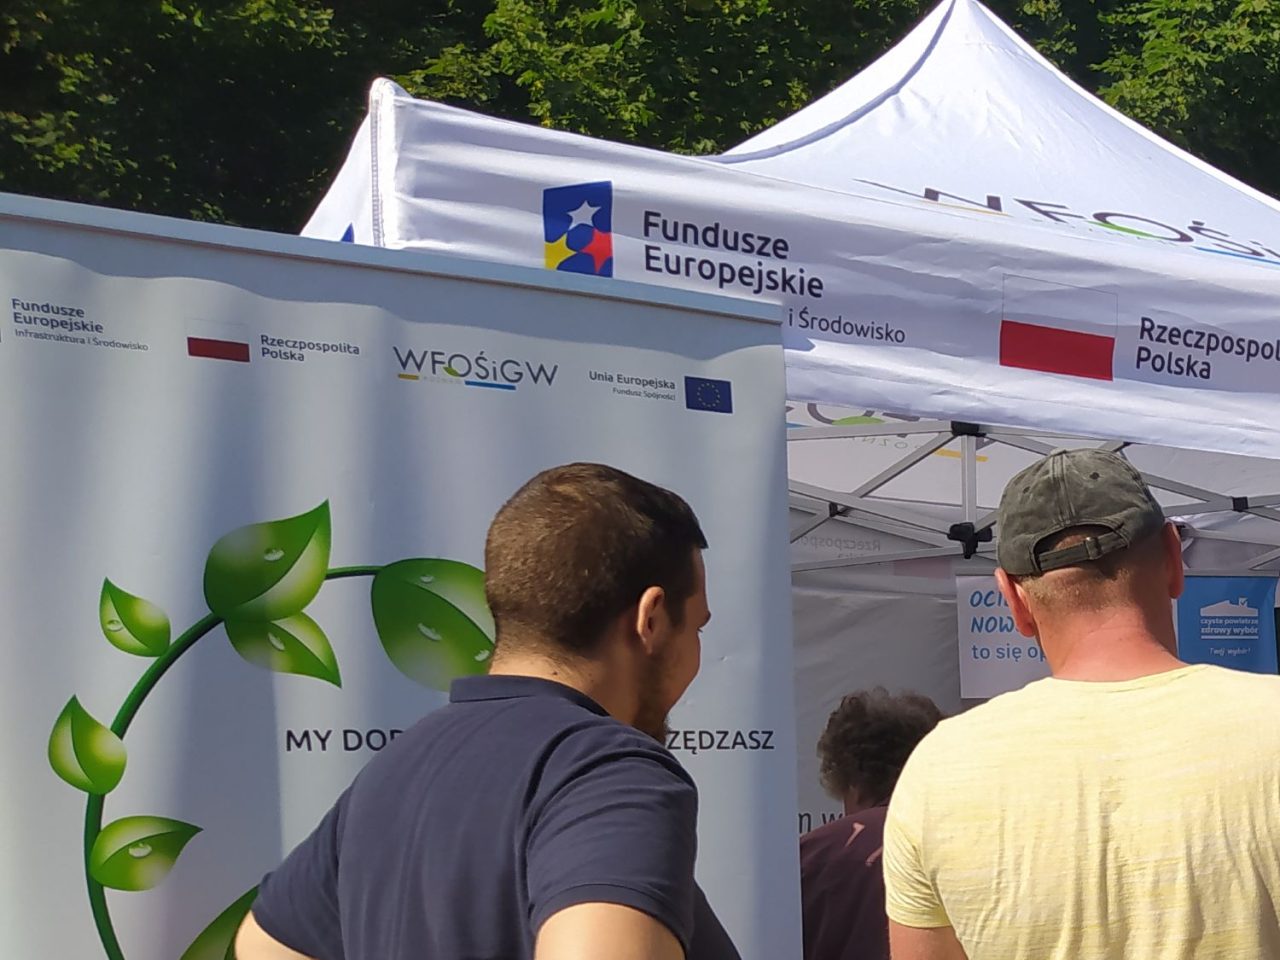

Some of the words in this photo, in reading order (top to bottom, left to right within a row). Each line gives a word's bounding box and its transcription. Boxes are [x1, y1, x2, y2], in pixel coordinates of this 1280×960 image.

[643, 210, 789, 260] Fundusze
[645, 244, 823, 298] Europejskie
[12, 299, 84, 318] Fundusze
[13, 312, 104, 334] Europejskie
[788, 308, 794, 327] i
[798, 307, 906, 344] Środowisko
[15, 329, 85, 345] Infrastruktura
[93, 335, 149, 351] Środowisko
[260, 334, 360, 356] Rzeczpospolita
[261, 347, 305, 362] Polska
[1135, 346, 1211, 380] Polska
[393, 346, 558, 386] WFOŚiGW
[588, 370, 614, 382] Unia
[616, 374, 676, 390] Europejska
[970, 616, 1019, 633] NOW
[972, 645, 990, 660] to
[996, 643, 1022, 663] się
[286, 729, 332, 751] MY
[667, 730, 775, 755] ZĘDZASZ
